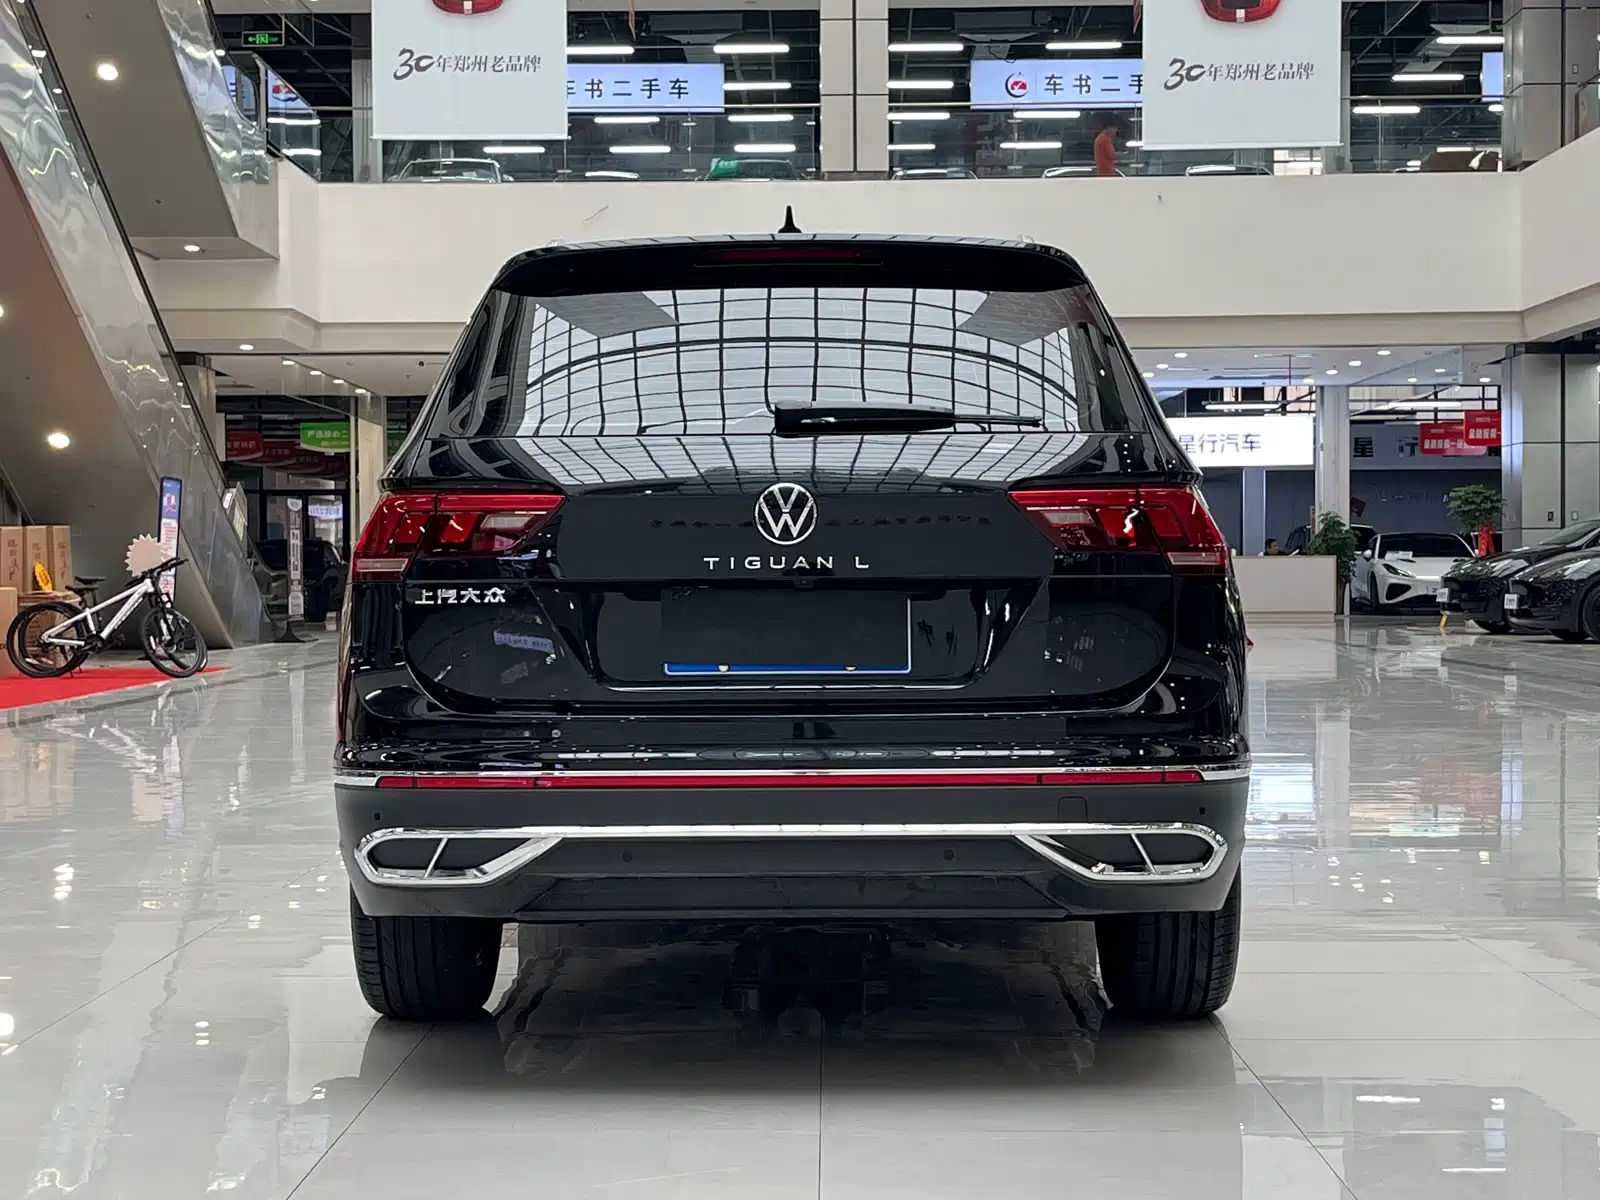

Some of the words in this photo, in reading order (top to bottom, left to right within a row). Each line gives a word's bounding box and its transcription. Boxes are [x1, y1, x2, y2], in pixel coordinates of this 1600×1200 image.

[393, 47, 542, 81] 30年郑州老品牌
[1163, 57, 1315, 90] 30年郑州老品牌
[1179, 433, 1262, 454] 星行汽车
[703, 556, 833, 570] TIGUAN
[855, 556, 870, 570] L
[414, 587, 506, 605] 上汽大众
